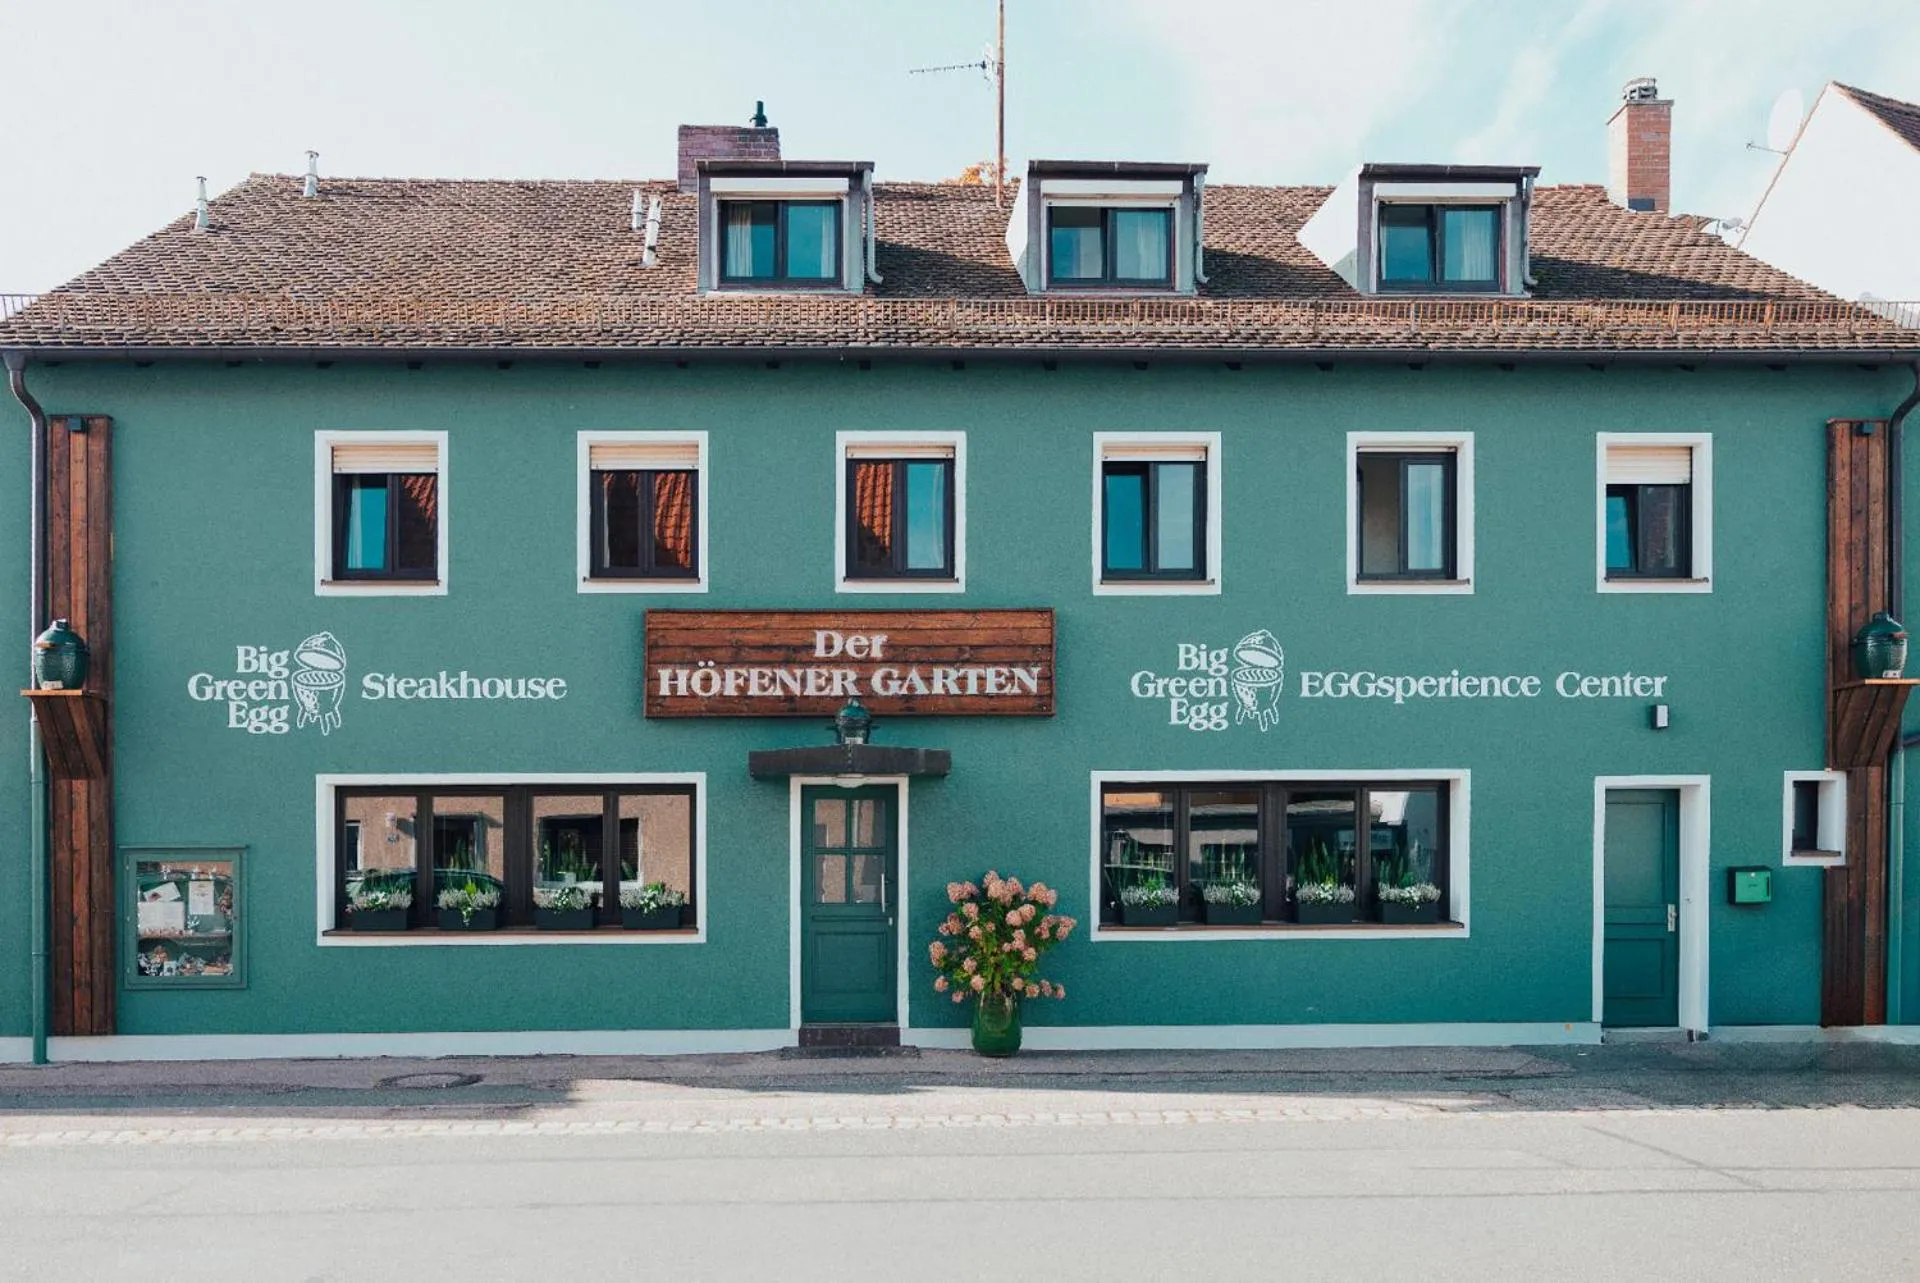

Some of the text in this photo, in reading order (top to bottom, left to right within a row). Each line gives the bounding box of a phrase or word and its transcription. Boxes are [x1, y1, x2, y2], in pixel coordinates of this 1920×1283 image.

[814, 630, 888, 658] Der
[1177, 643, 1229, 675] Big
[236, 645, 289, 679] Big
[187, 672, 289, 701] Green
[361, 670, 568, 700] Steakhouse
[657, 660, 1042, 697] HÖFENER GARTEN
[1130, 670, 1229, 698] Green
[1299, 669, 1668, 704] EGGsperience Center
[227, 701, 290, 735] Egg
[1169, 698, 1229, 731] Egg
